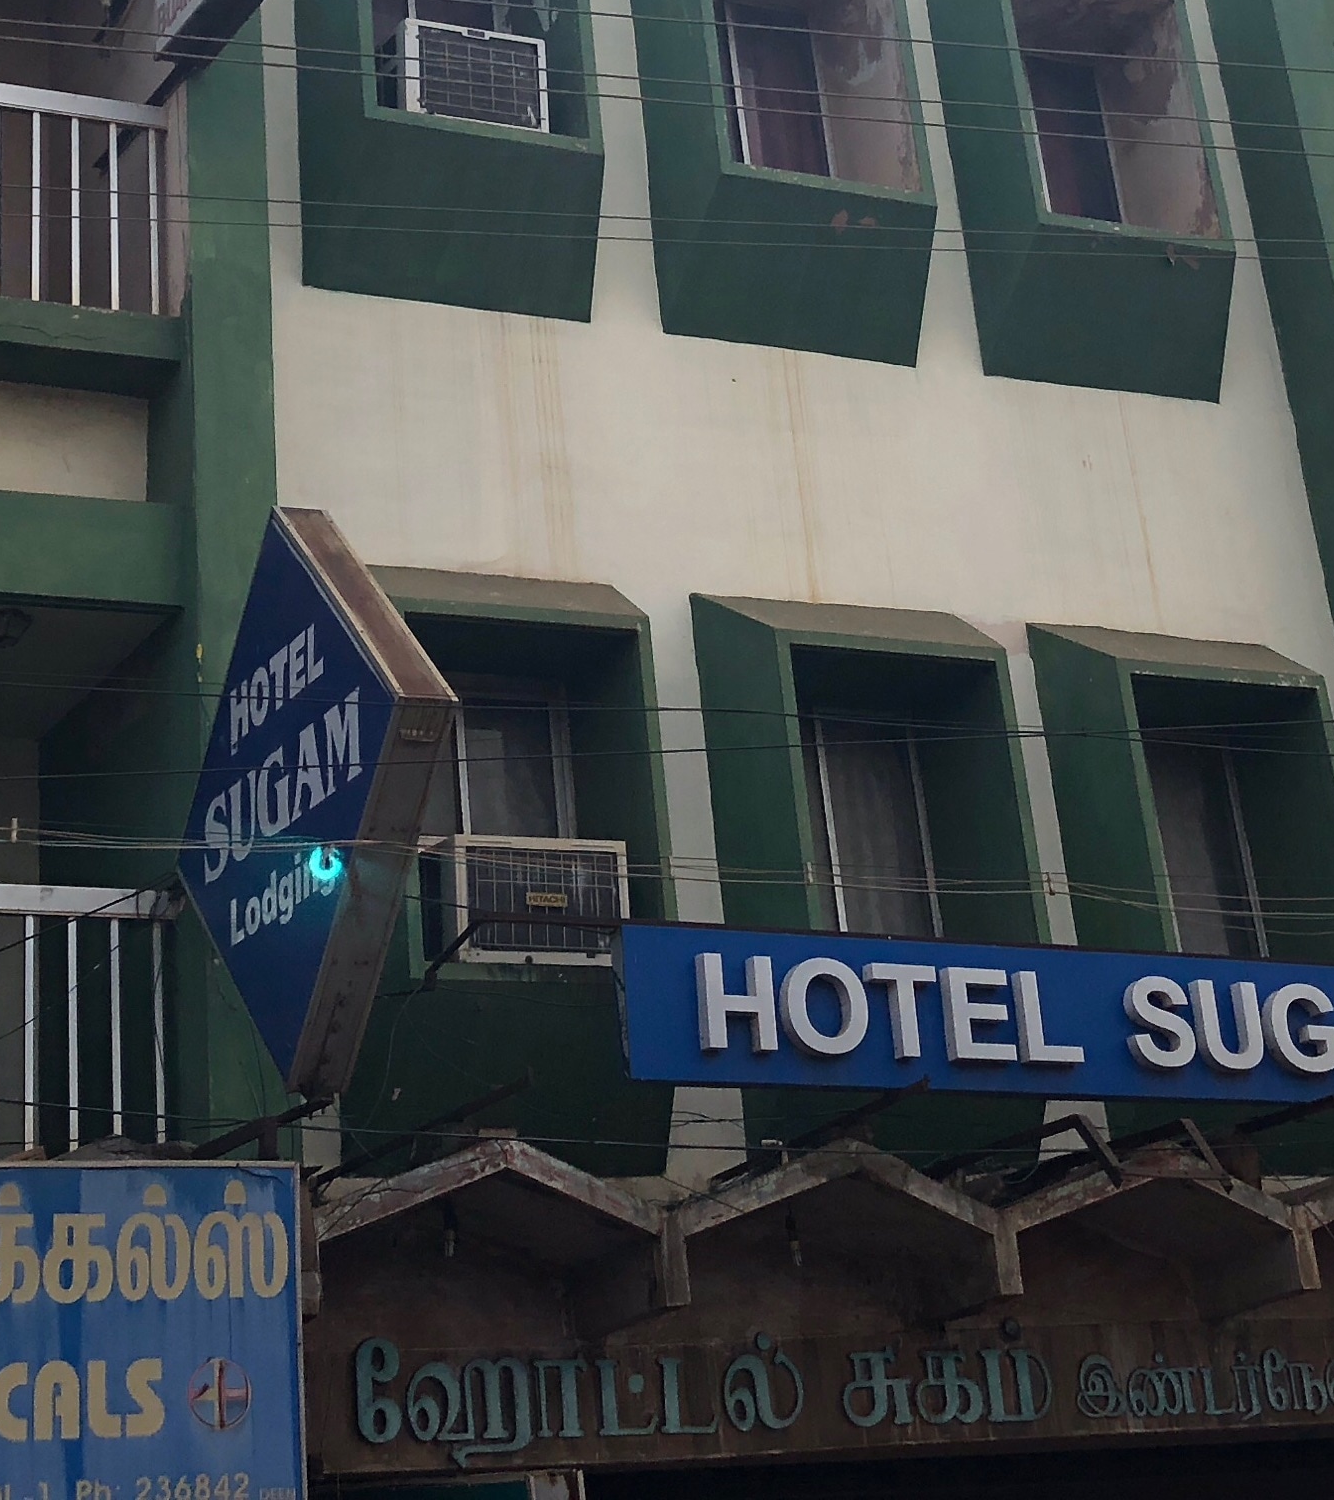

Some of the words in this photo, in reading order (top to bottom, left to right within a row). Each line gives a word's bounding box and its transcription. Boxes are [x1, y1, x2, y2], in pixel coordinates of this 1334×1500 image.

[229, 623, 325, 757] HOTEL
[203, 687, 363, 886] SUGAM
[694, 951, 1085, 1064] HOTEL
[353, 1331, 805, 1470] ஹோட்டல்
[842, 1317, 1053, 1426] சுகம்
